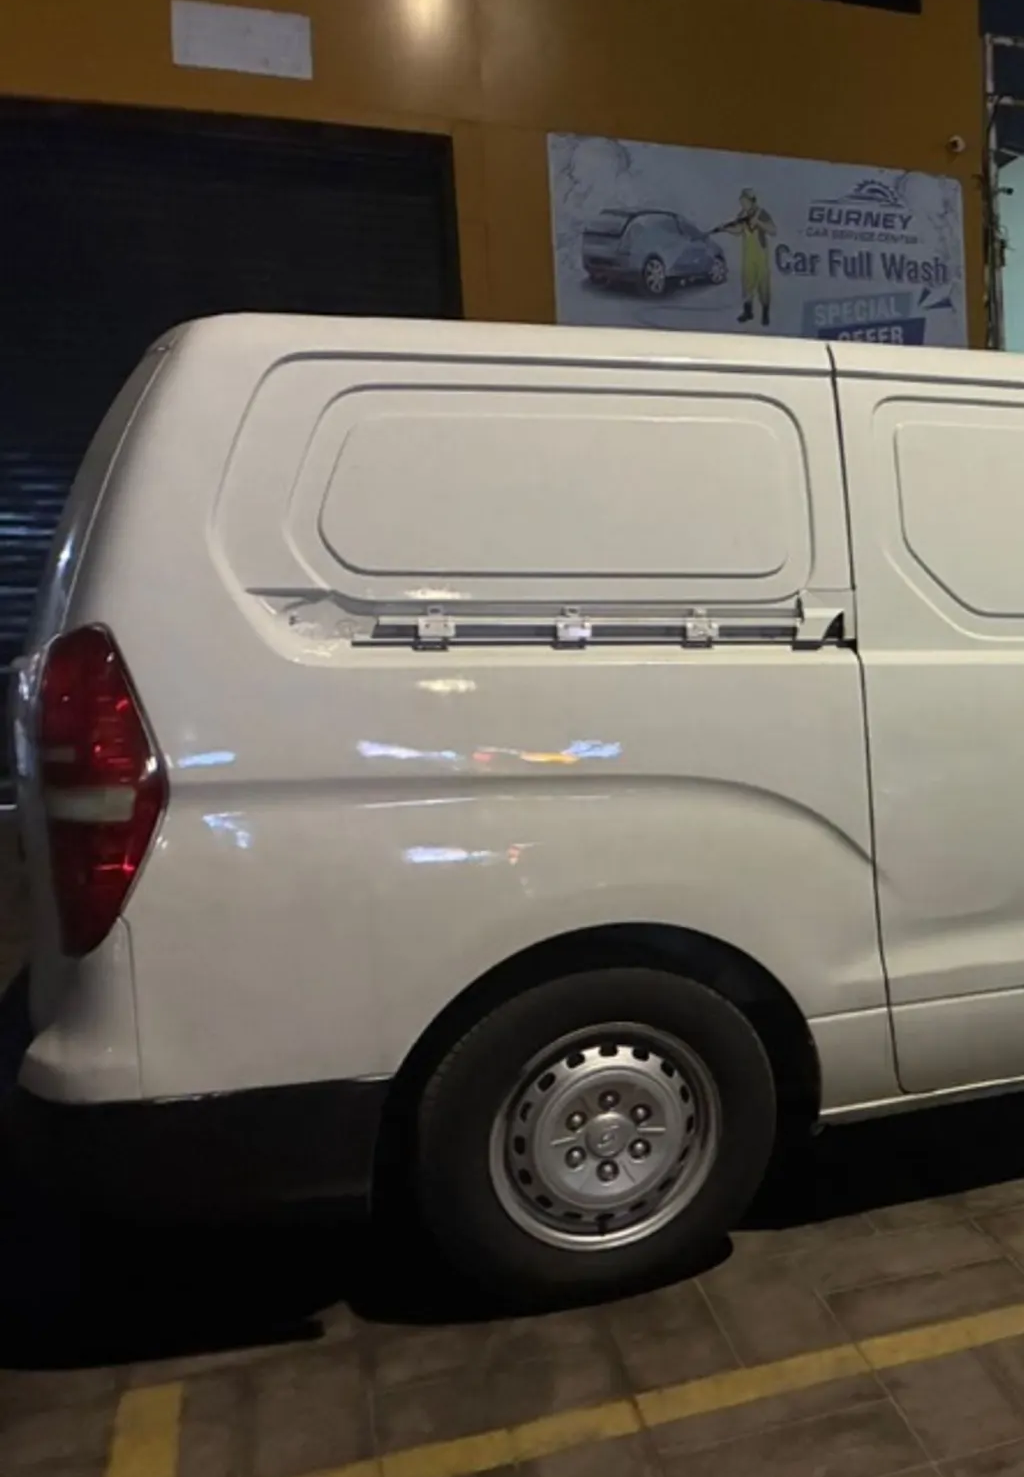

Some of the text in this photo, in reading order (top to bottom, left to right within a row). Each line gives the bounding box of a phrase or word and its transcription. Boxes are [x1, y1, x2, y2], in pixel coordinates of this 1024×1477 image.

[807, 206, 913, 230] GURNEY
[805, 227, 918, 244] CAR SERVICE CENTER
[774, 243, 949, 284] Car Full Wash
[814, 296, 903, 326] SPECIAL
